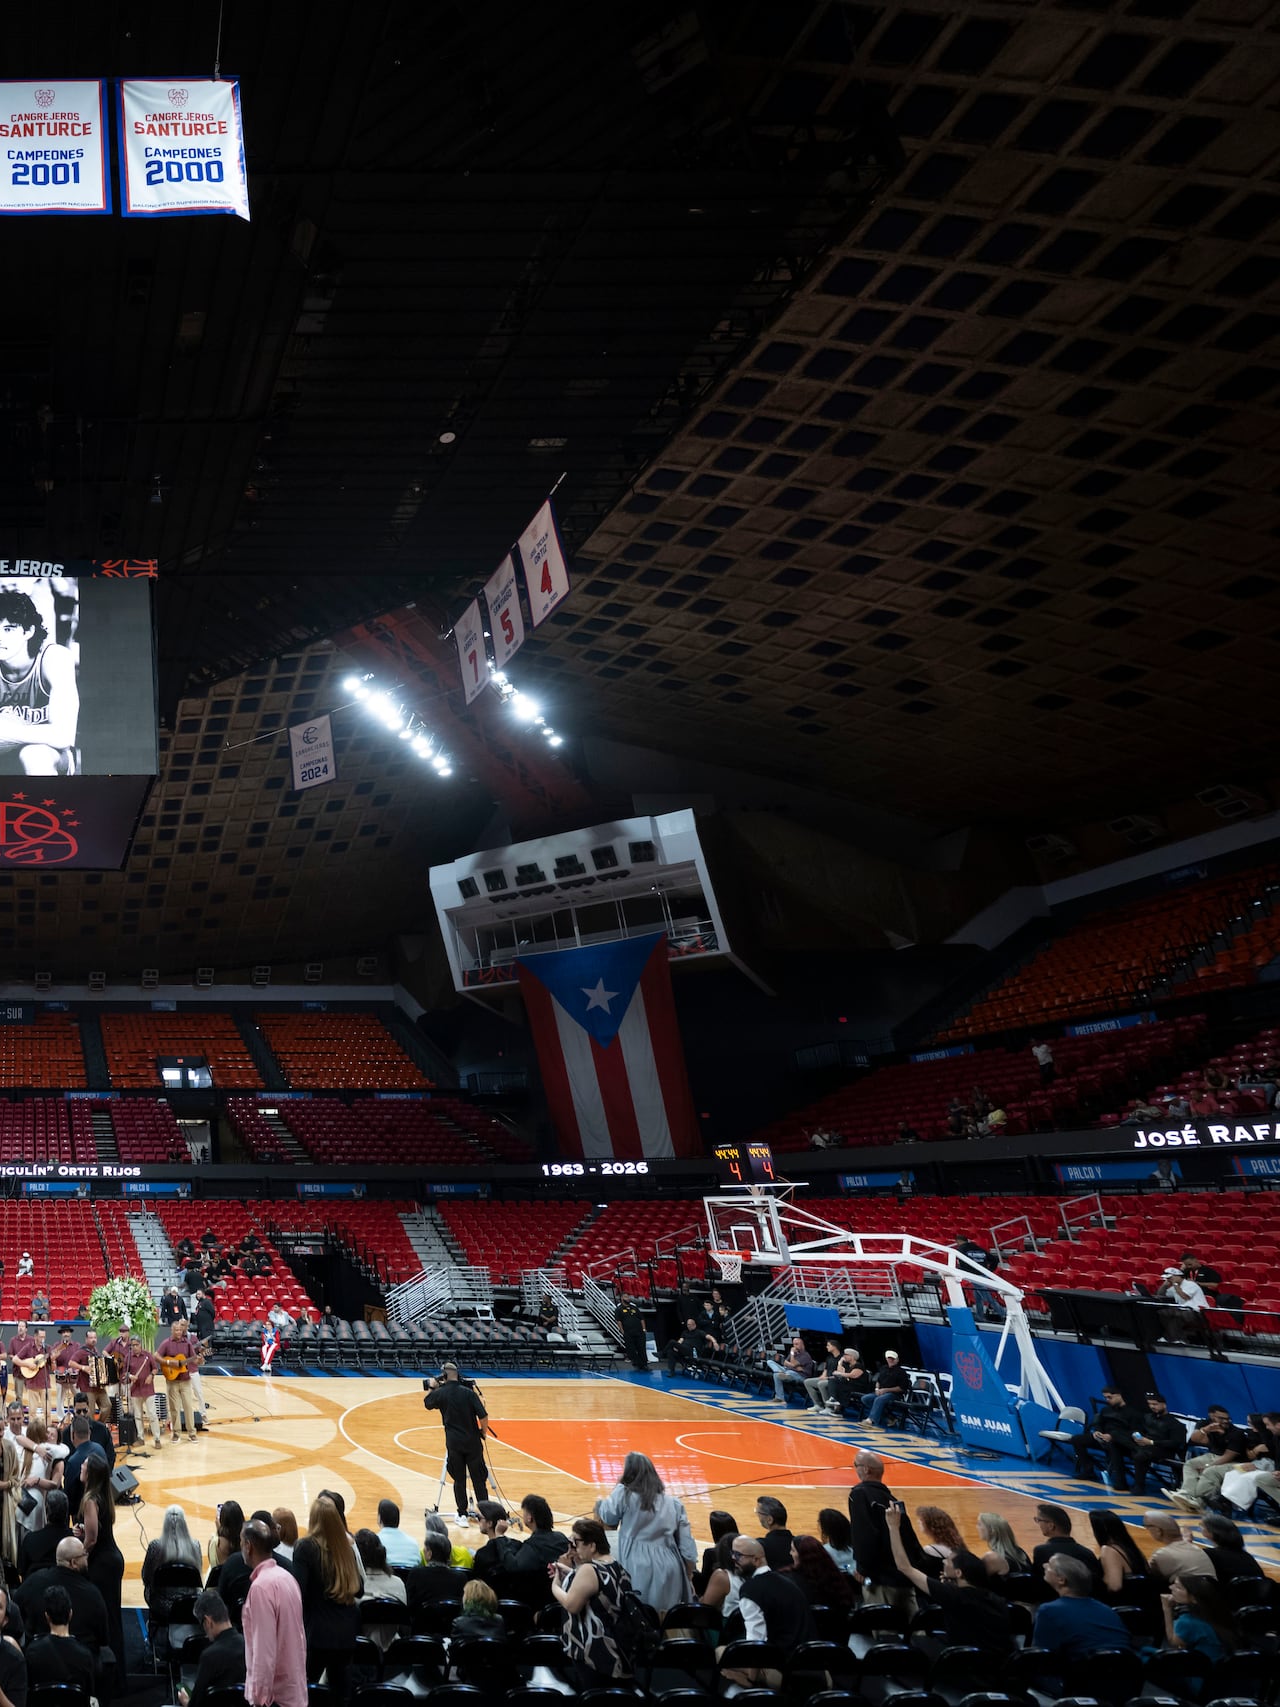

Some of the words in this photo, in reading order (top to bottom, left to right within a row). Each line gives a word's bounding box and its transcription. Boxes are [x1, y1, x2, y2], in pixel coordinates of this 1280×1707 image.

[10, 112, 80, 123] CANGREJEROS
[145, 112, 215, 122] CANGREJEROS
[134, 120, 229, 137] SANTURCE
[7, 148, 84, 161] CAMPEONES
[144, 147, 222, 159] CAMPEONES
[12, 162, 80, 186] 2001
[145, 160, 225, 186] 2000
[541, 560, 553, 595] 4
[500, 608, 515, 645] 5
[468, 649, 479, 683] 7
[301, 764, 329, 782] 2024
[6, 1008, 23, 1020] SUR
[1134, 1124, 1201, 1149] JOSÉ
[58, 1166, 99, 1176] ORTIZ
[102, 1166, 142, 1177] RIJOS
[542, 1163, 585, 1176] 1963
[600, 1162, 649, 1176] 2026
[730, 1161, 742, 1182] 4
[762, 1160, 775, 1181] 4
[1067, 1166, 1095, 1180] PALCO
[1095, 1166, 1103, 1179] Y
[29, 1183, 45, 1192] PALCO
[130, 1184, 145, 1192] PALCO
[304, 1184, 320, 1193] PALCO
[960, 1414, 982, 1427] SAN
[984, 1418, 1012, 1434] JUAN
